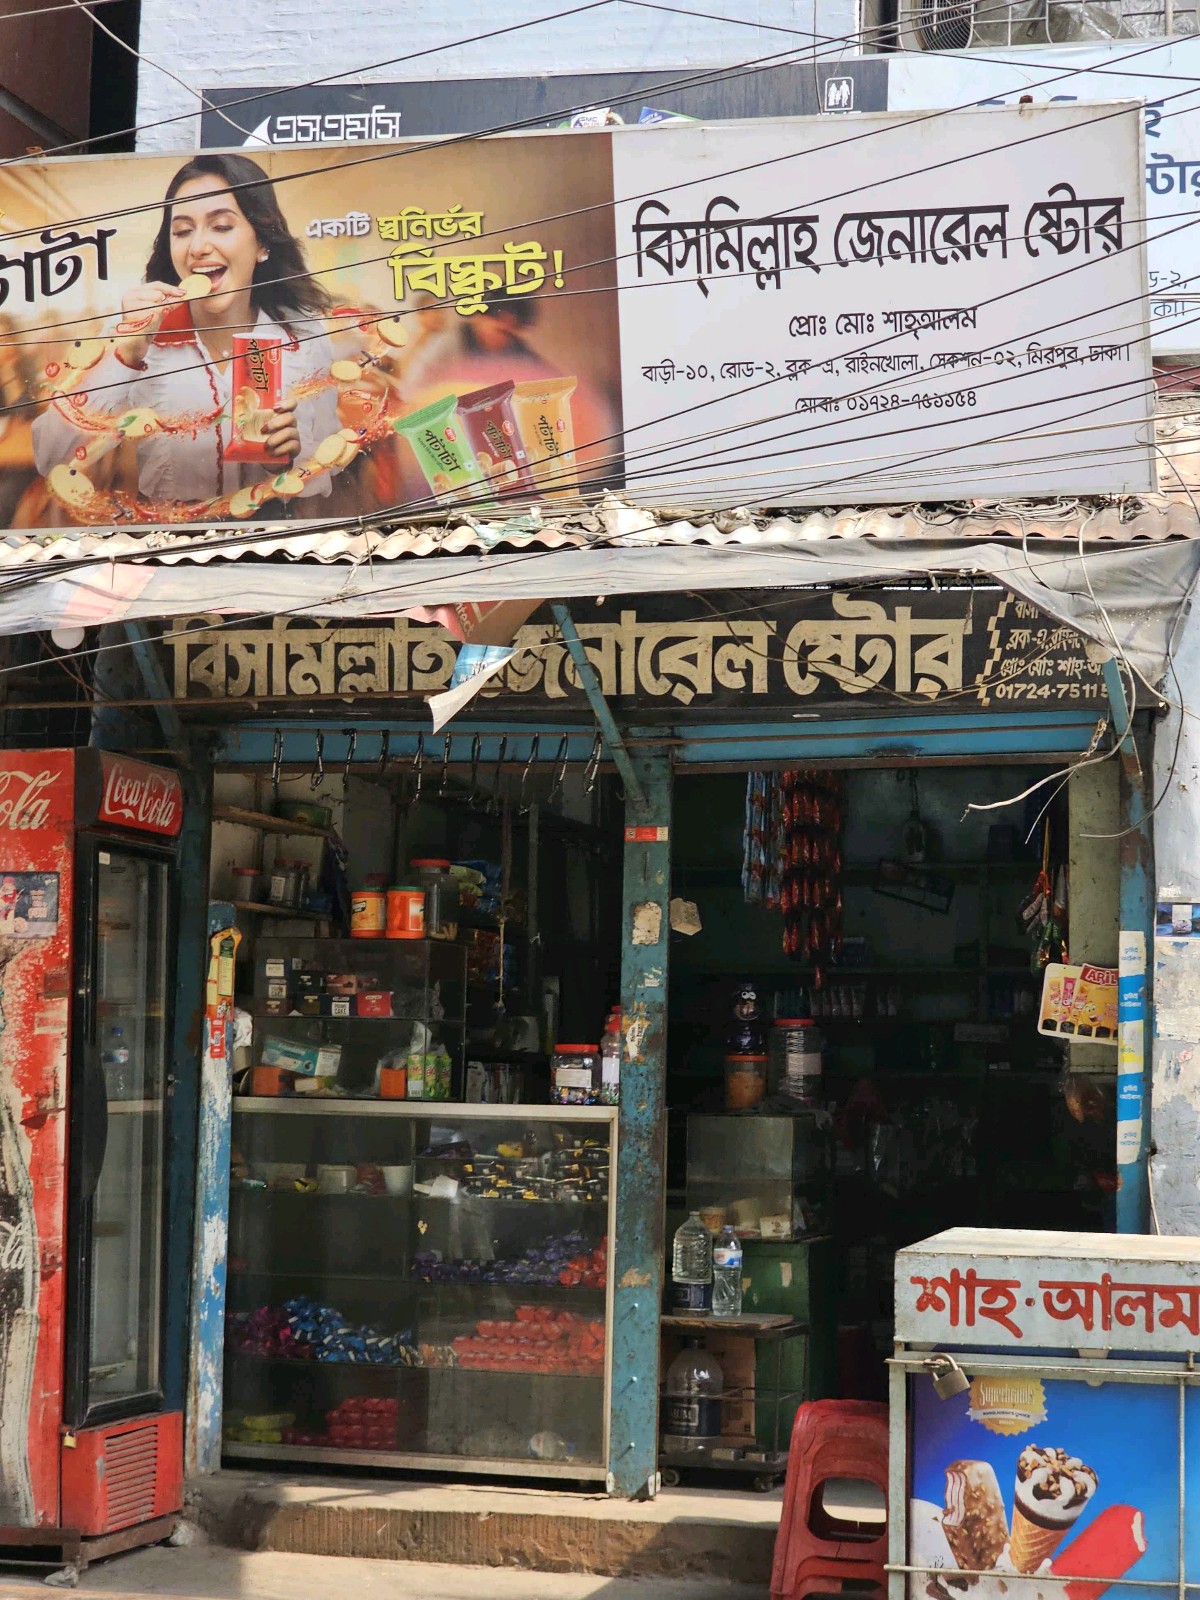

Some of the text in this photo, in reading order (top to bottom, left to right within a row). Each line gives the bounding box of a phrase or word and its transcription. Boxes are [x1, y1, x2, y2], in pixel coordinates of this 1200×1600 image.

[273, 104, 402, 143] এসএমসি
[304, 204, 485, 241] একটি স্বনির্ভর
[834, 204, 1009, 267] জেনারেল
[1025, 182, 1125, 257] ষ্টোর
[788, 314, 827, 338] প্রোঃ
[835, 312, 875, 335] মোঃ
[720, 361, 781, 379] রোড-২,
[782, 592, 973, 699] ষ্টোর
